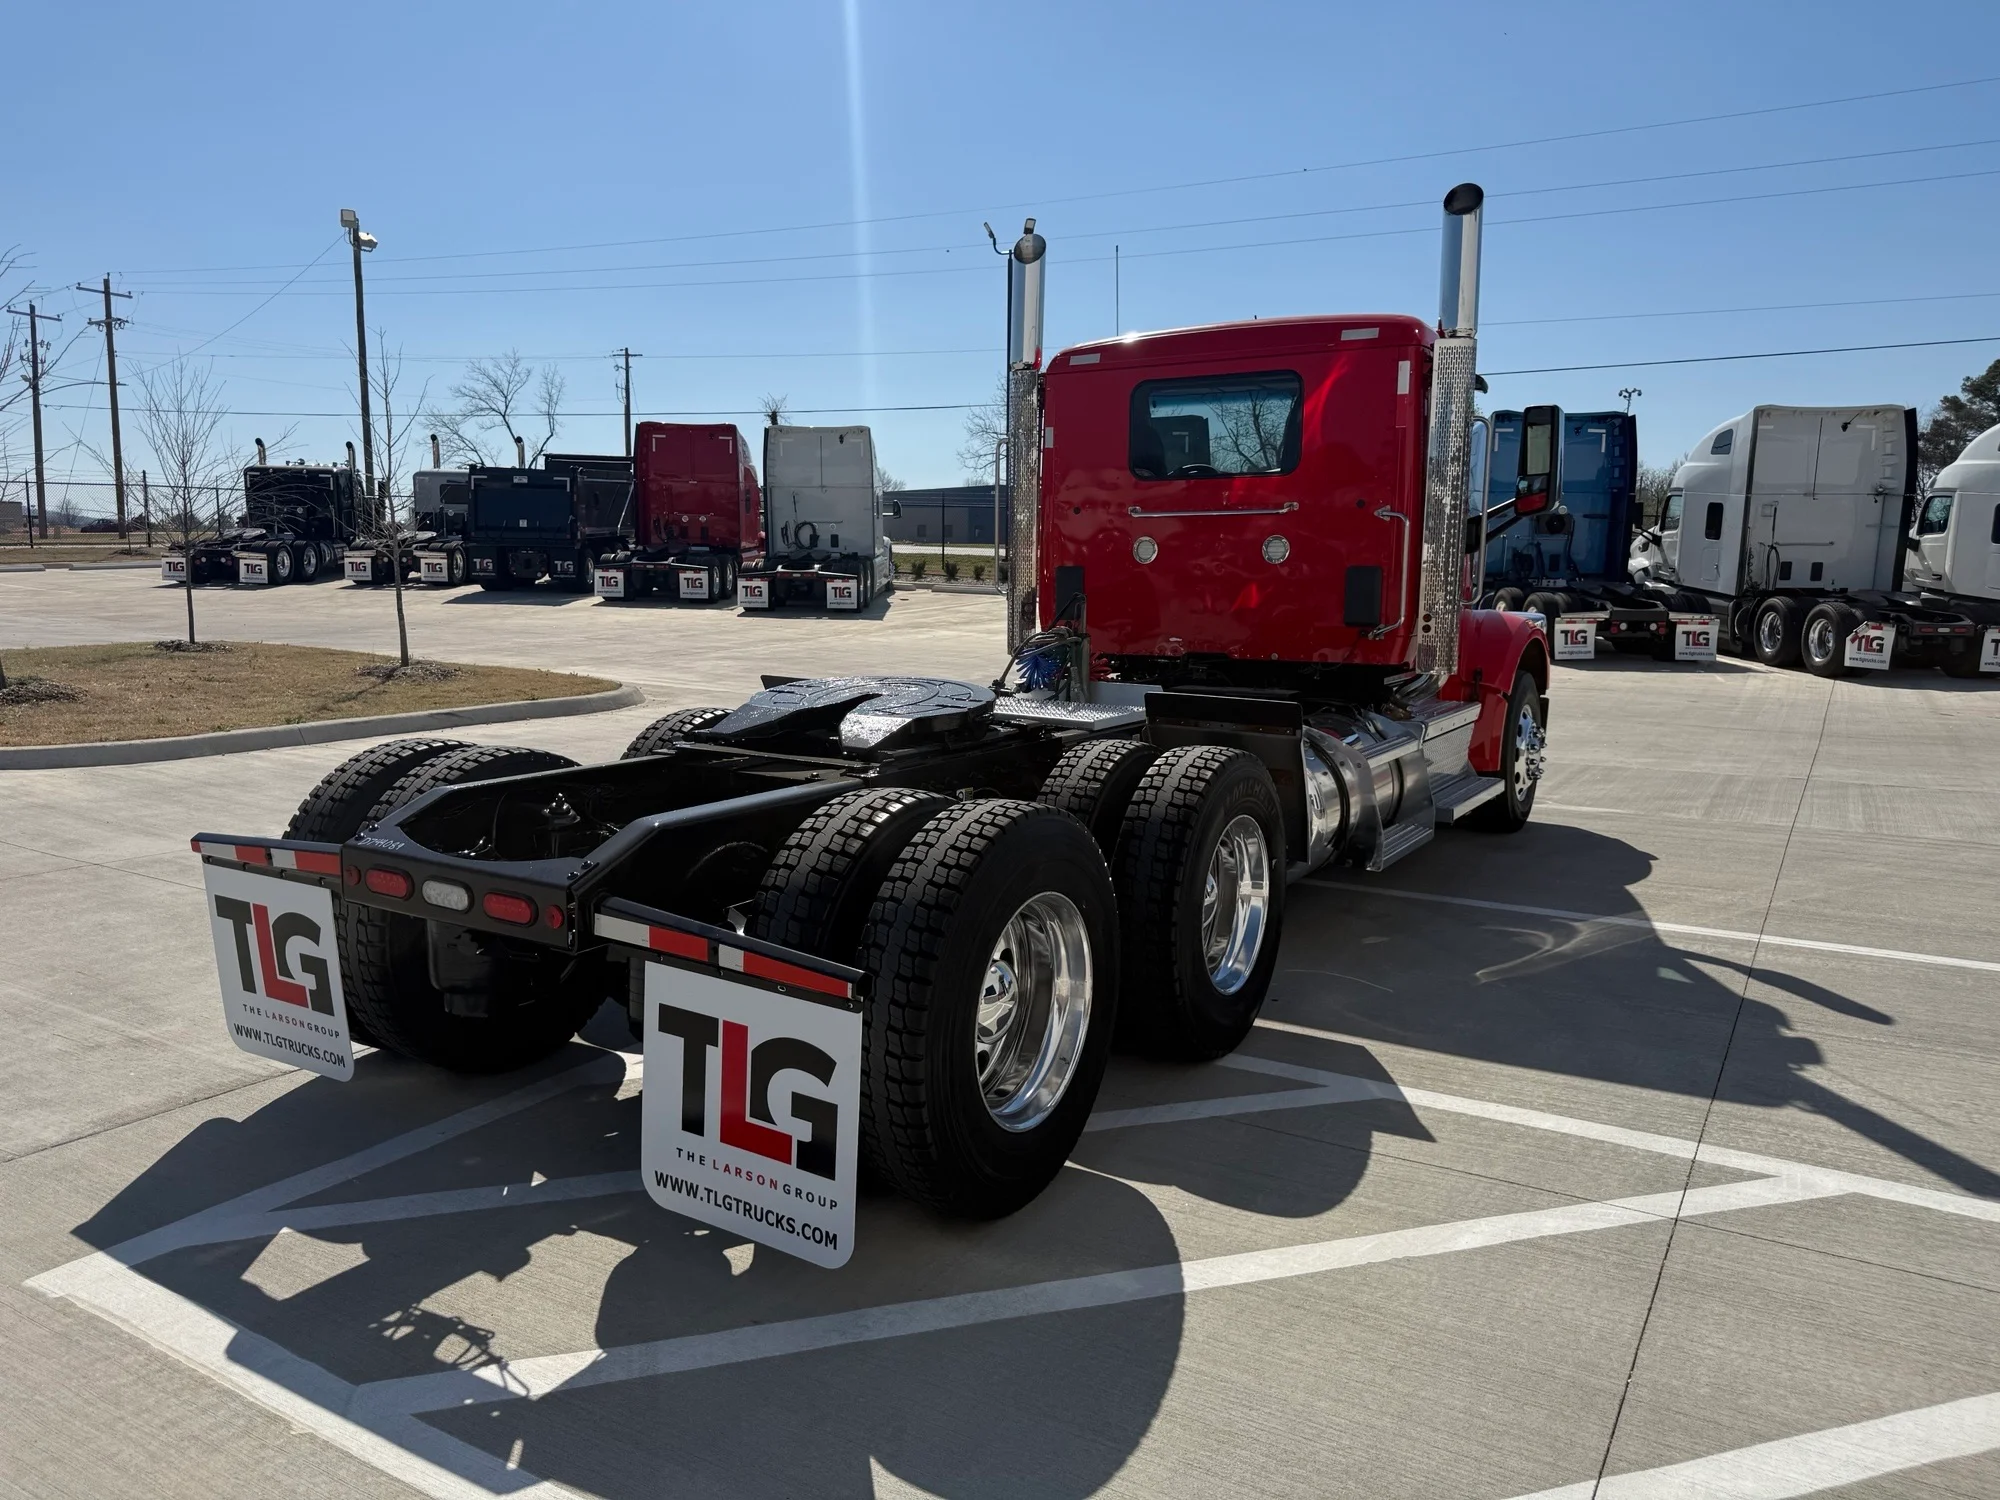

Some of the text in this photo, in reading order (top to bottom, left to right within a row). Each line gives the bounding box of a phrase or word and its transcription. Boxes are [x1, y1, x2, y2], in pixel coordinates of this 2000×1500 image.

[166, 561, 184, 572] TLG
[244, 563, 262, 574] TLG
[348, 561, 367, 572] TLG
[425, 562, 443, 573] TLG
[473, 558, 493, 570] TLG
[554, 560, 574, 572] TLG
[598, 576, 618, 587] TLG
[684, 577, 703, 589] TLG
[742, 585, 763, 598] TLG
[831, 586, 852, 598] TLG
[1560, 629, 1588, 646] TLG
[1681, 630, 1710, 647] TLG
[1855, 634, 1885, 653] TLG
[214, 894, 335, 1017] TLG
[243, 1003, 340, 1039] THE LARSON GROUP
[233, 1022, 346, 1068] WWW.TLGTRUCKS.COM
[658, 1002, 838, 1181] TLG
[676, 1147, 838, 1211] THE LARSON GROUP
[654, 1169, 838, 1251] WWW.TLGTRUCKS.COM
